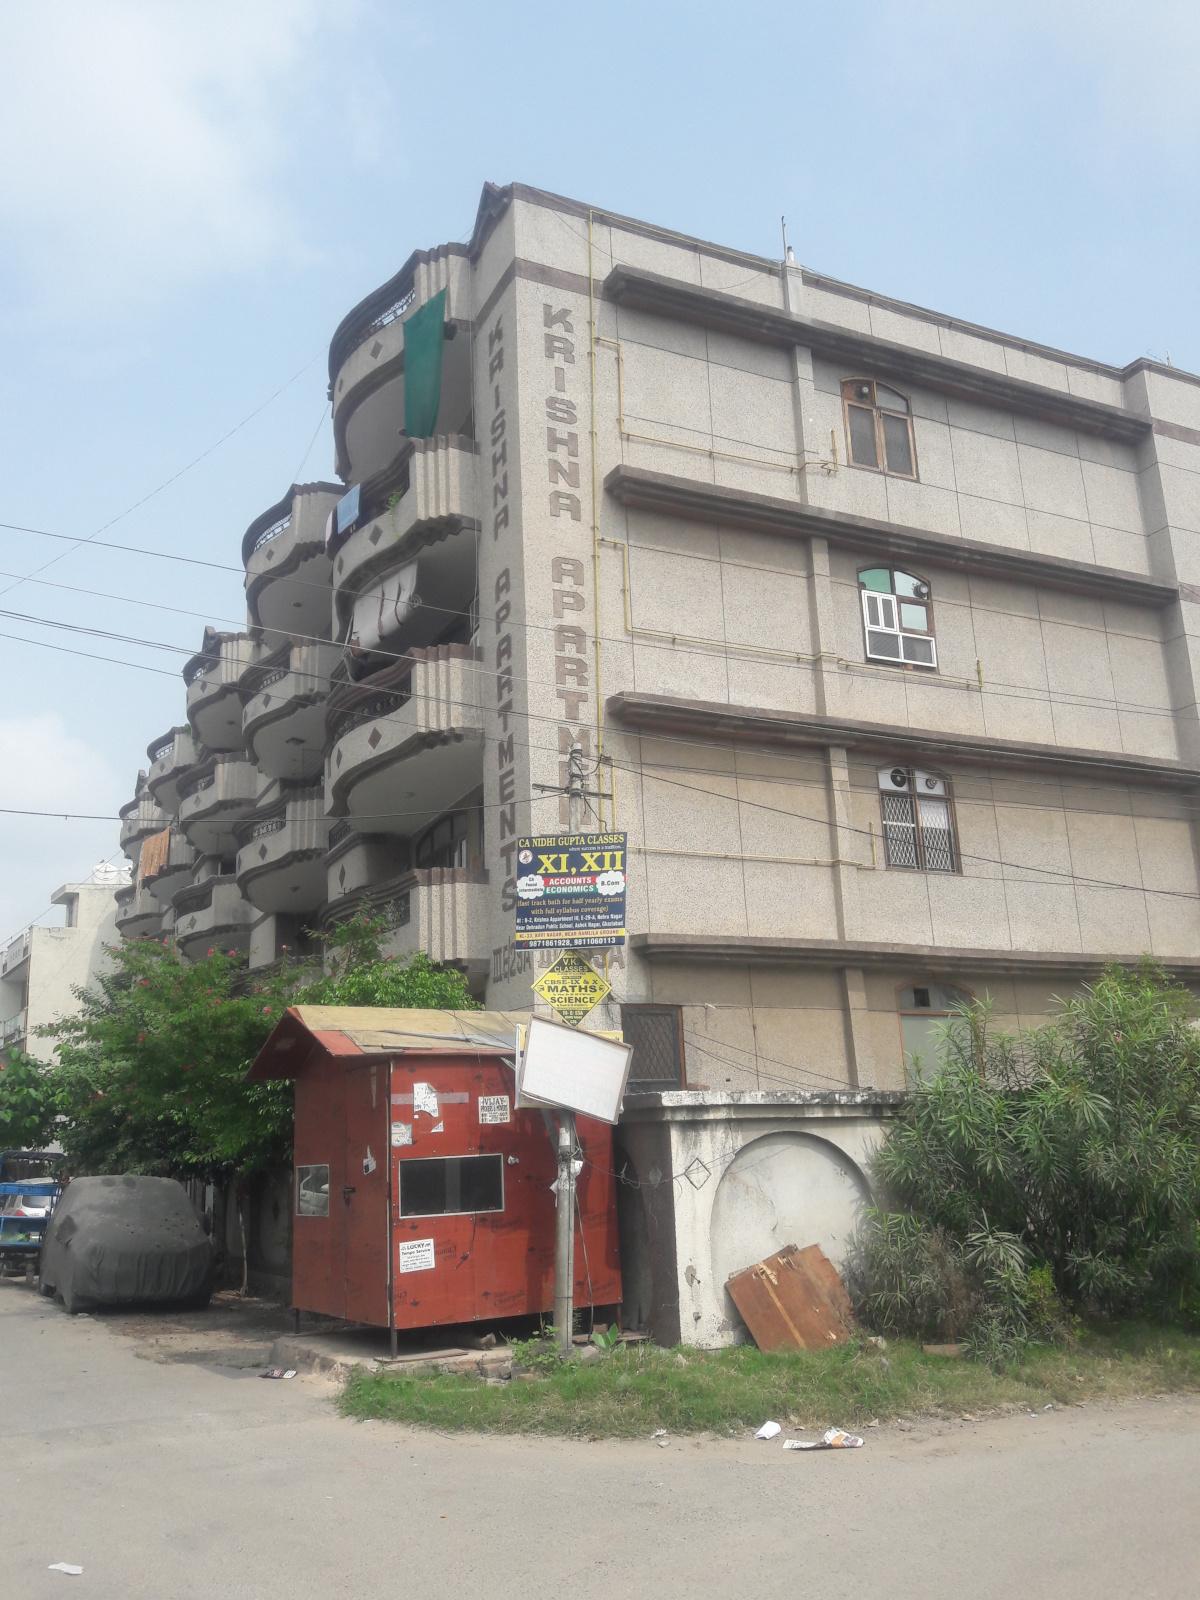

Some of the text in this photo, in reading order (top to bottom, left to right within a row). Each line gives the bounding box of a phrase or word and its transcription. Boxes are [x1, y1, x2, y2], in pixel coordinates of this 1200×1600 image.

[542, 303, 582, 522] KRISHNA
[488, 313, 510, 542] KRISHNA
[518, 835, 624, 848] CA NIDHI GUPTA CLASSES
[537, 851, 624, 875] XI, XII
[549, 877, 592, 885] ACCOUNTS
[546, 885, 594, 894] ECONOMICS
[584, 897, 603, 905] yearly
[556, 907, 579, 915] syllabus
[581, 905, 609, 913] coverage)
